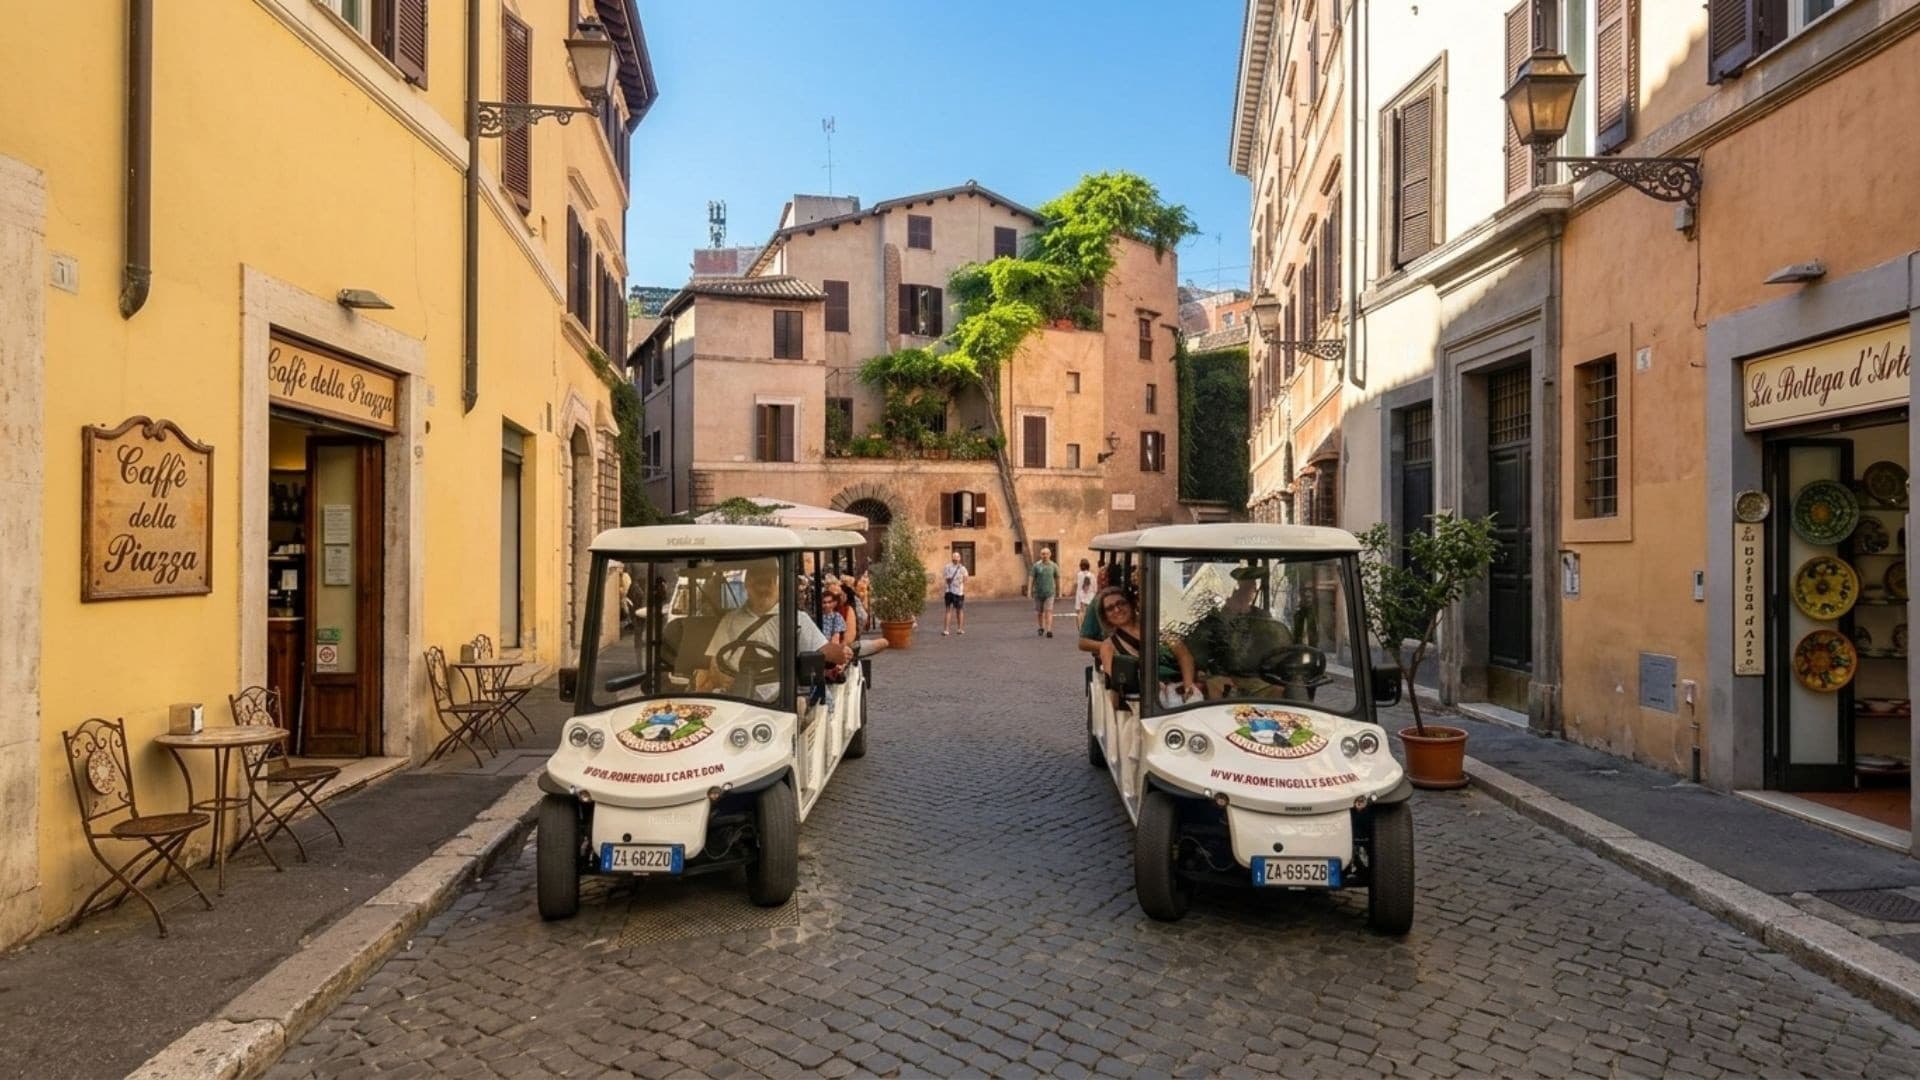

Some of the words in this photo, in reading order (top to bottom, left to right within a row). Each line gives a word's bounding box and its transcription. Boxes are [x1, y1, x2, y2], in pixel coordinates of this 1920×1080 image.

[268, 347, 308, 397] Caffè
[310, 364, 346, 400] della
[1749, 371, 1772, 408] La
[1776, 364, 1845, 407] Bottega
[1849, 341, 1910, 388] d'Arte
[117, 444, 188, 499] Caffè
[128, 501, 177, 529] della
[103, 533, 199, 584] Piazza
